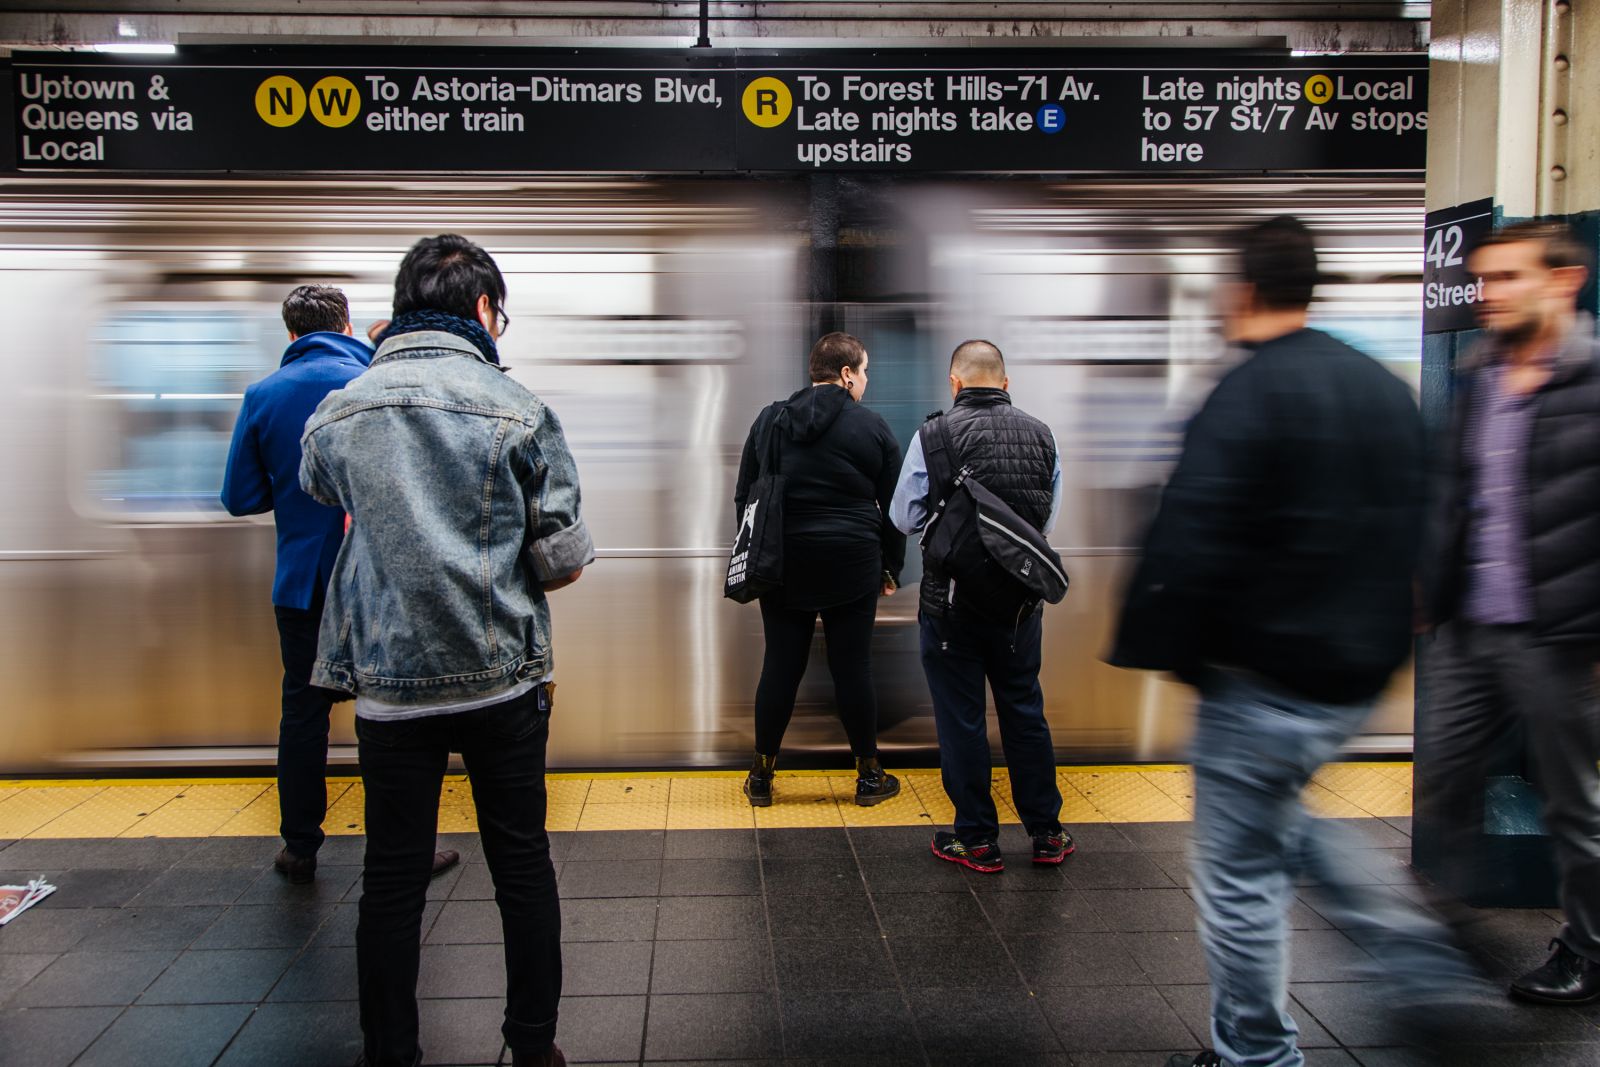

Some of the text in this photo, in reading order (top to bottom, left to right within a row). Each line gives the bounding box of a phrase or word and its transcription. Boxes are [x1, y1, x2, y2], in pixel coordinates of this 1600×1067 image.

[22, 75, 169, 103] Uptown &
[269, 87, 352, 116] N W
[366, 76, 399, 100] To
[655, 78, 722, 108] Blvd,
[757, 89, 777, 115] R
[798, 76, 830, 101] To
[844, 76, 934, 100] Forest
[1059, 76, 1099, 100] Av.
[1143, 76, 1412, 107] Late nights Q Local
[23, 102, 193, 130] Queens via
[367, 107, 524, 131] either train
[798, 106, 1057, 136] Late nights take E
[1143, 102, 1427, 135] to 57 St/7 Av stops
[24, 136, 103, 160] Local
[798, 138, 911, 167] upstairs
[1142, 137, 1203, 162] here
[1426, 225, 1463, 269] 42
[1425, 277, 1485, 309] Street
